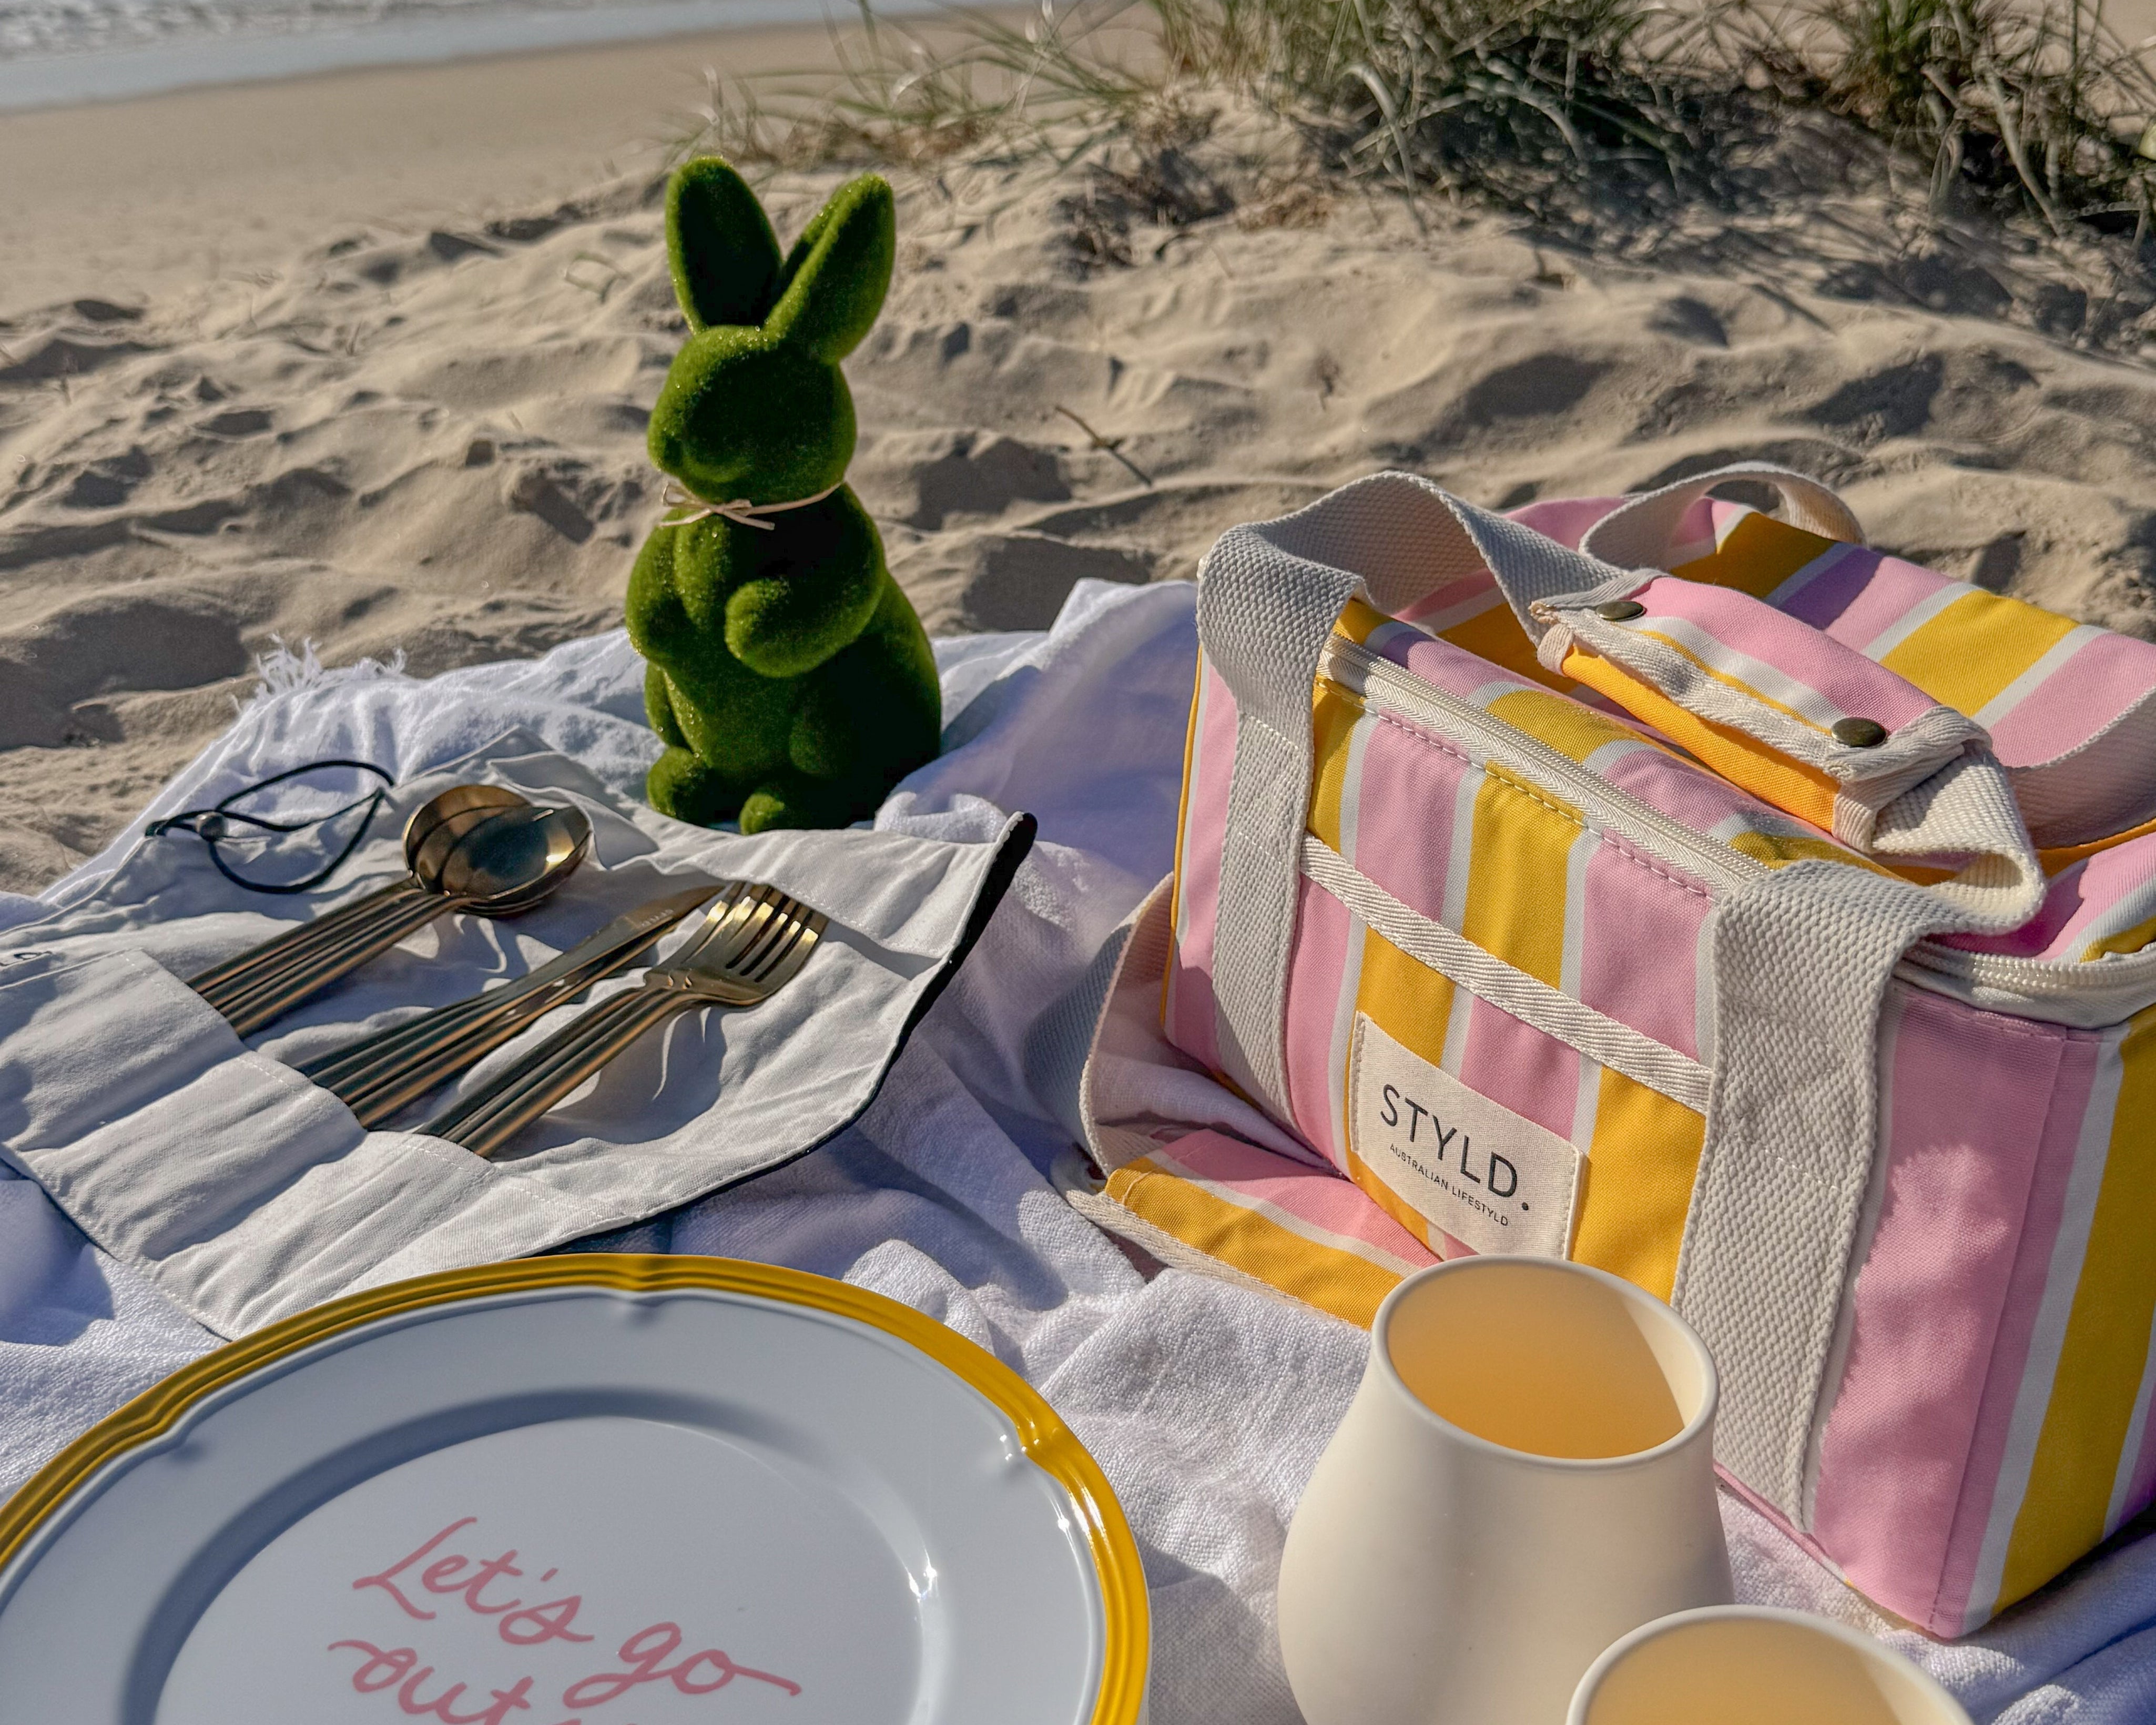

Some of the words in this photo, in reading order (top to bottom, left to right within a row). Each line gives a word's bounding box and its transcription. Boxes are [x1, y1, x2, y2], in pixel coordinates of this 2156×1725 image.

[1380, 1084, 1529, 1211] STYLD.
[1390, 1143, 1449, 1191] AUSTRALIAN
[1452, 1185, 1509, 1227] LIFESTYLD
[352, 1516, 595, 1645] Let's
[563, 1621, 802, 1709] go
[327, 1639, 535, 1725] out
